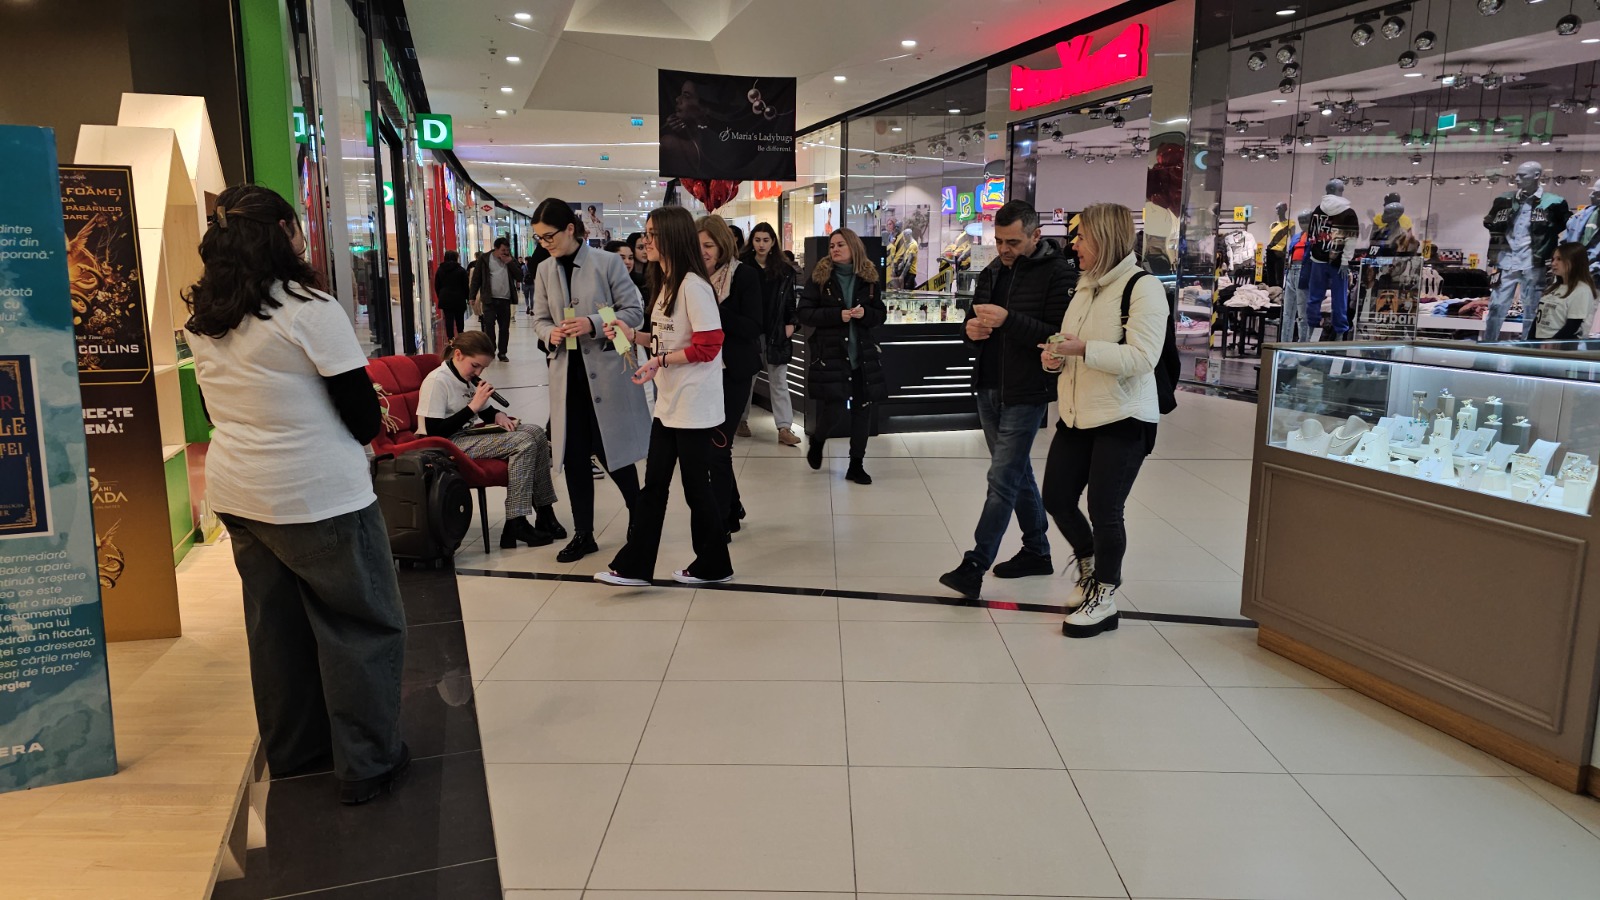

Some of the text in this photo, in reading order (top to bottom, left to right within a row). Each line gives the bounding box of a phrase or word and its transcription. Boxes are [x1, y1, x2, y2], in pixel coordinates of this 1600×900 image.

[422, 119, 448, 143] D
[731, 131, 793, 143] Maria's Ladybugs
[19, 237, 39, 246] din
[78, 344, 140, 354] COLLINS
[35, 562, 71, 573] apare
[18, 588, 33, 597] ce
[36, 586, 62, 595] este
[56, 618, 70, 627] lui
[39, 632, 50, 640] în
[53, 626, 92, 639] flăcări.
[17, 646, 31, 654] se
[34, 638, 96, 652] adresează
[61, 650, 92, 660] mele,
[22, 668, 38, 677] de
